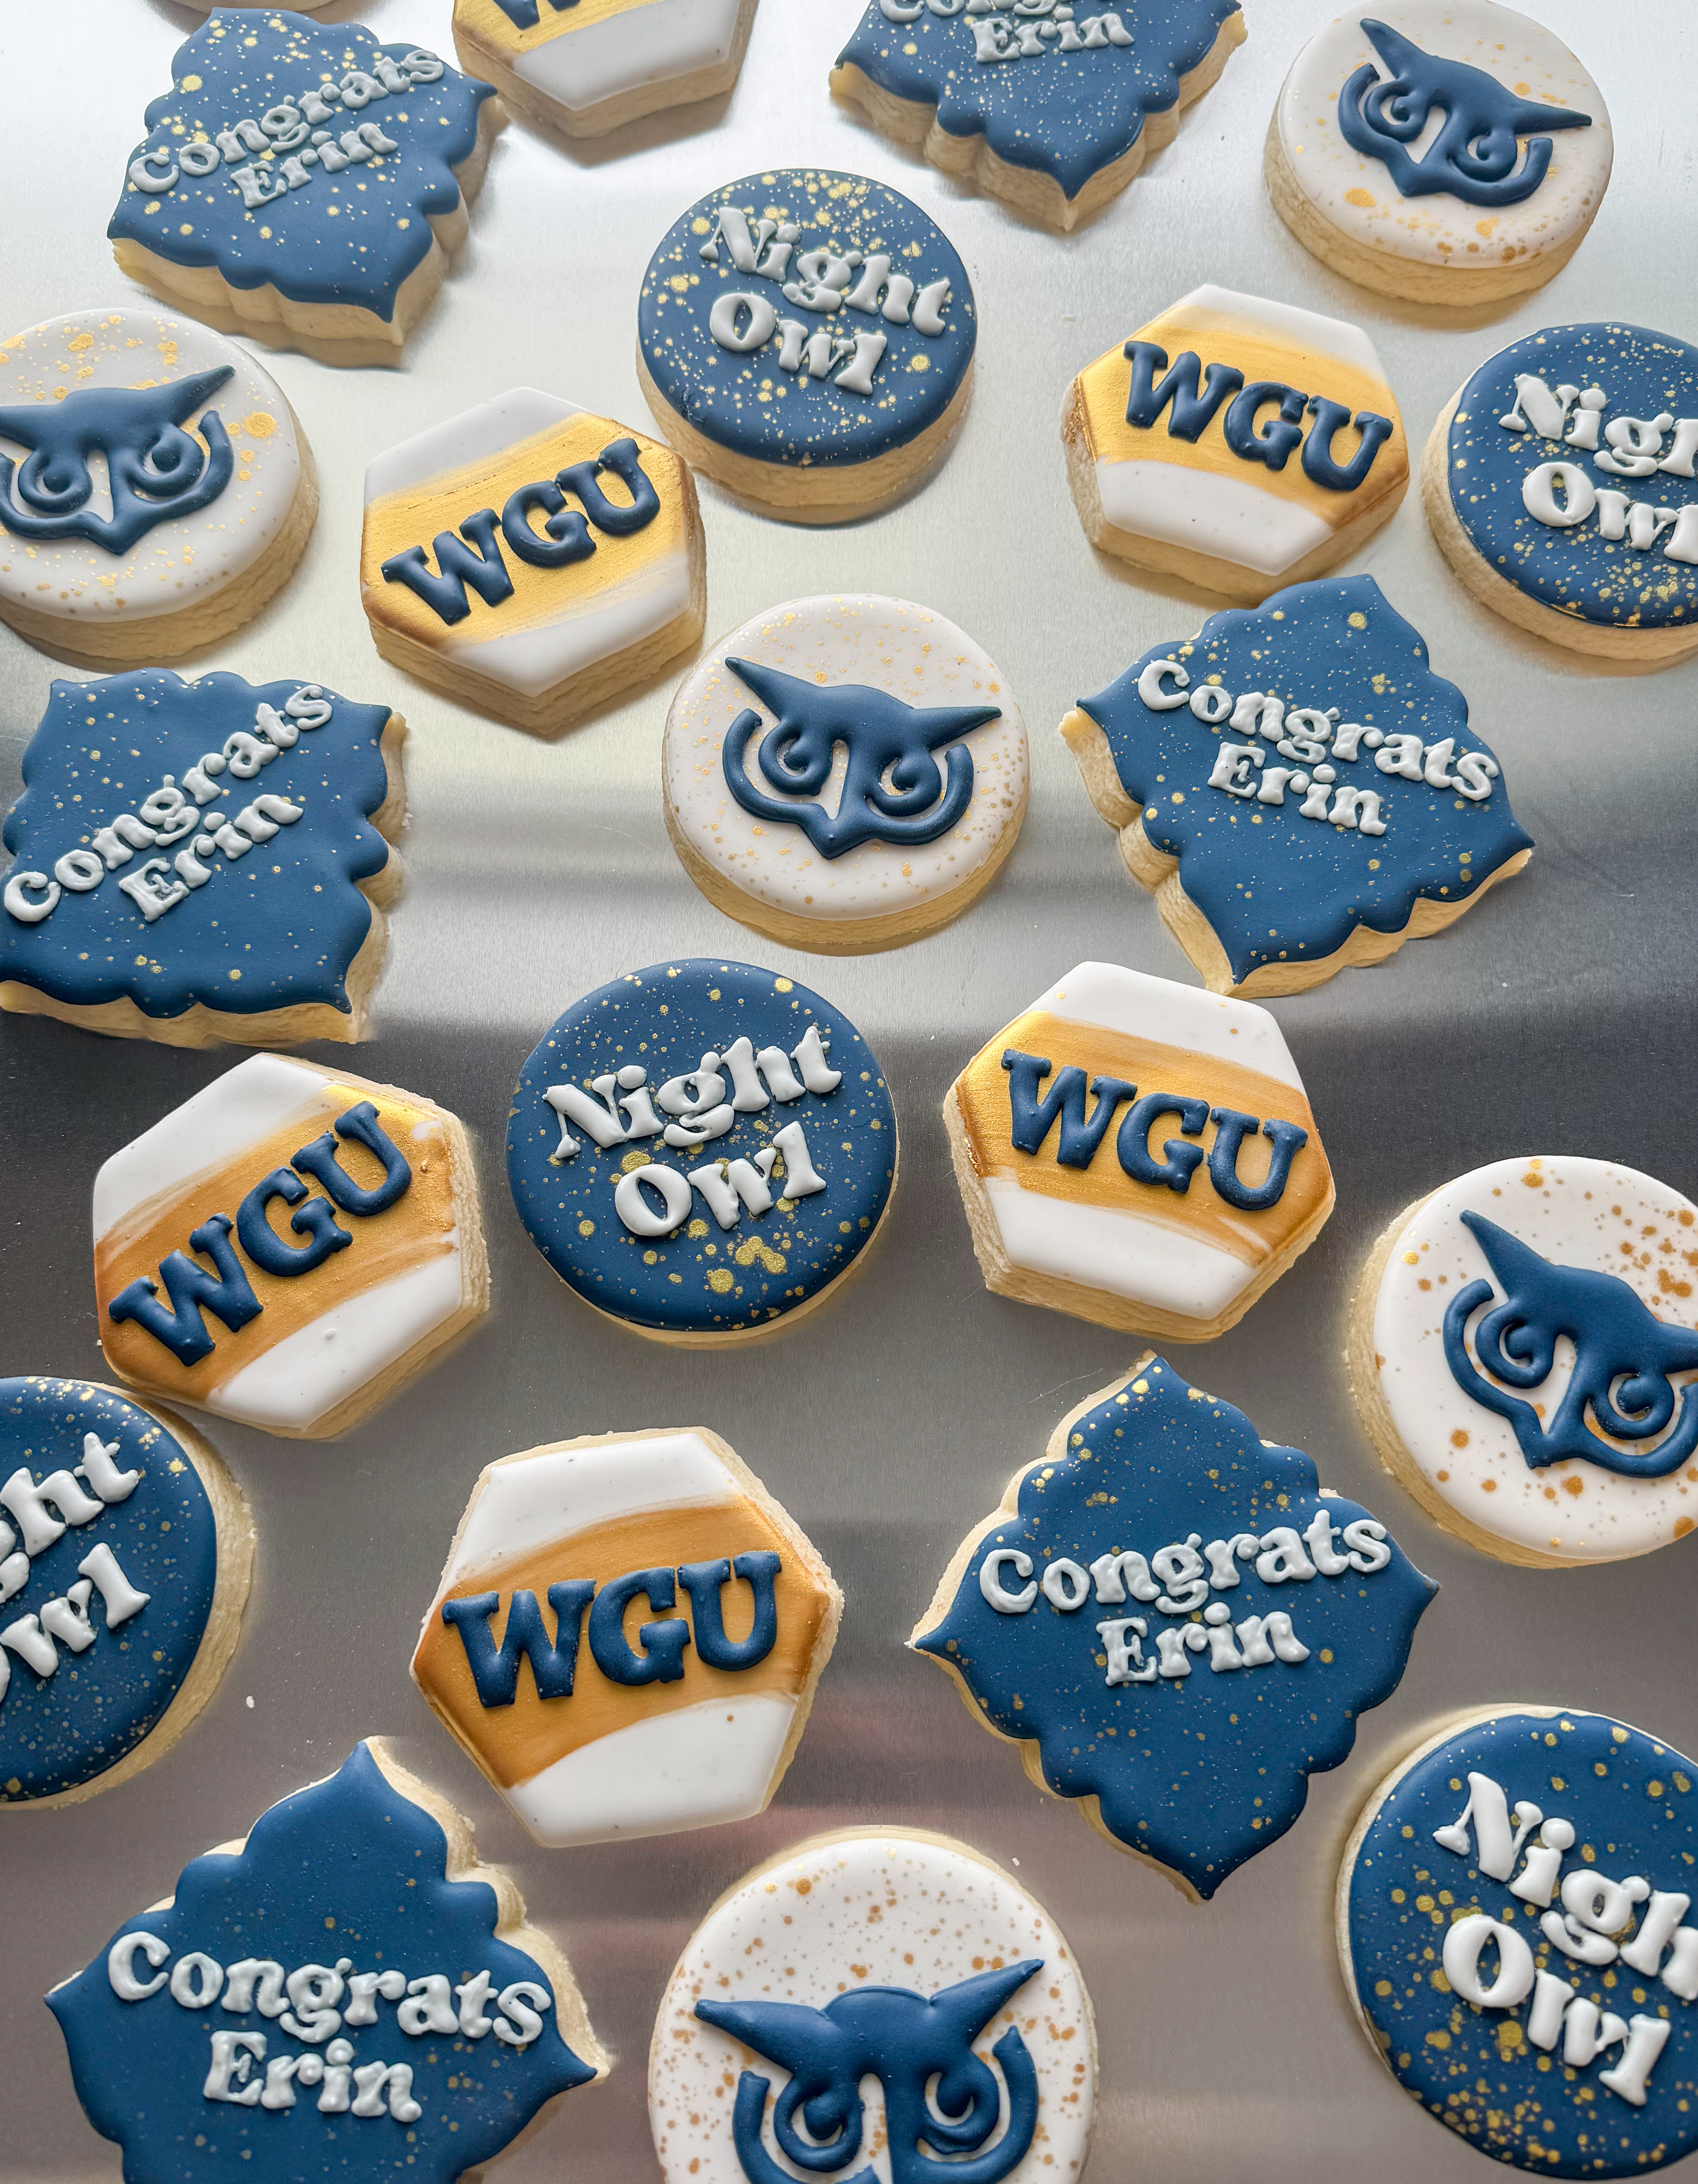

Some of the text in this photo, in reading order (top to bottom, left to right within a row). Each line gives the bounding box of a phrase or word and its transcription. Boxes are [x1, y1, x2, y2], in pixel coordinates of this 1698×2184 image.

[970, 7, 1134, 63] Erin
[129, 49, 444, 193] Congrats
[230, 123, 398, 208] Erin
[699, 207, 951, 337] Night
[709, 293, 887, 395] Owl
[1123, 340, 1393, 491] WGU
[381, 438, 660, 625] WGU
[1138, 659, 1500, 801] Congrats
[1208, 741, 1387, 836] Erin
[3, 684, 333, 922] Congrats
[118, 794, 303, 922] Erin
[542, 1026, 842, 1159] Night
[1002, 1049, 1308, 1211] WGU
[108, 1101, 413, 1366] WGU
[615, 1121, 826, 1236] Owl
[0, 1542, 151, 1704] wl
[979, 1510, 1391, 1615] Congrats
[442, 1550, 782, 1708] WGU
[1096, 1602, 1309, 1686] Erin
[108, 1931, 552, 2046] Congrats
[1443, 1913, 1671, 2106] Owl
[204, 2031, 422, 2122] Erin
